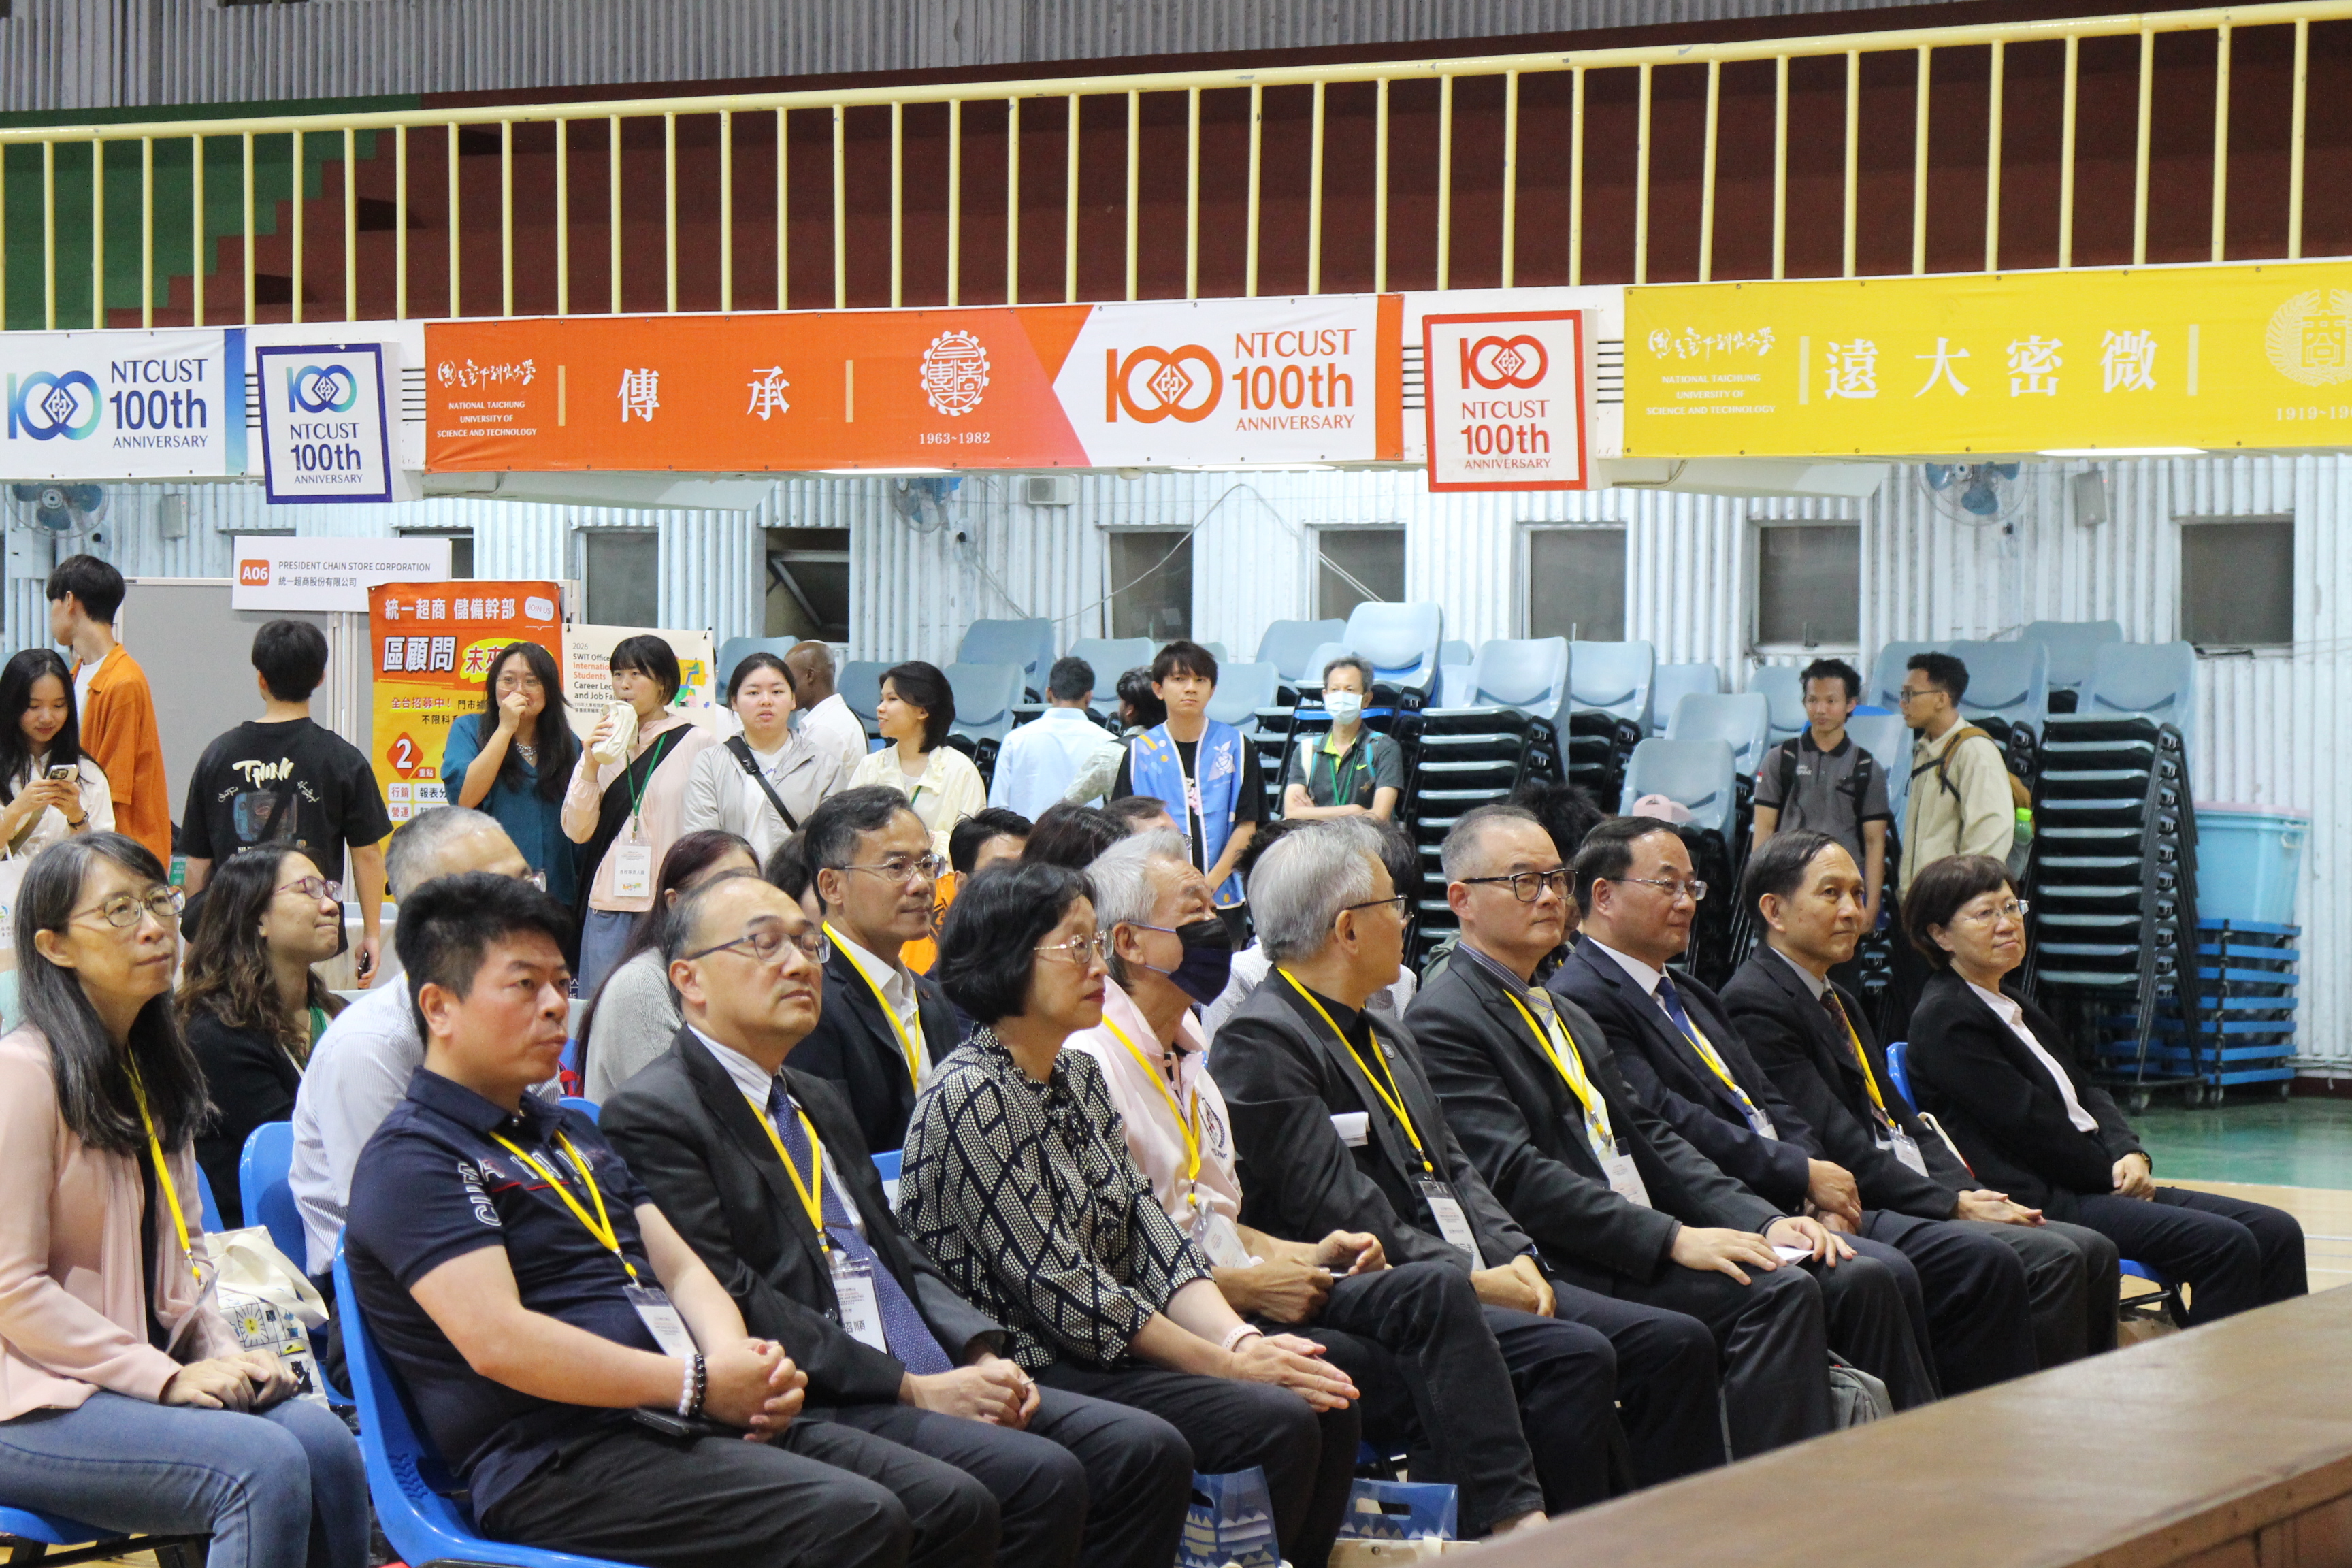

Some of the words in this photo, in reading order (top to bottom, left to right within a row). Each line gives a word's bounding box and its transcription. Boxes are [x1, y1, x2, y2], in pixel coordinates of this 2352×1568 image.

[1235, 329, 1357, 359] NTCUST
[112, 358, 208, 384] NTCUST
[1662, 375, 1709, 383] NATIONAL
[1711, 374, 1761, 382] TAICHUNG
[1232, 363, 1354, 410] 100th
[1676, 391, 1730, 399] UNIVERSITY
[1732, 390, 1745, 398] OF
[110, 390, 206, 430] 100th
[448, 402, 485, 410] NATIONAL
[1462, 399, 1550, 420] NTCUST
[1646, 407, 1686, 415] SCIENCE
[1688, 406, 1708, 414] AND
[1710, 405, 1776, 414] TECHNOLOGY
[459, 415, 502, 423] UNIVERSITY
[2276, 406, 2352, 421] 1919~19
[1236, 414, 1355, 431] ANNIVERSARY
[290, 422, 359, 440] NTCUST
[437, 429, 468, 438] SCIENCE
[487, 428, 537, 436] TECHNOLOGY
[112, 434, 208, 449] ANNIVERSARY
[1460, 423, 1550, 455] 100th
[290, 443, 361, 471] 100th
[1465, 458, 1551, 470] ANNIVERSARY
[294, 474, 363, 485] ANNIVERSARY
[242, 566, 268, 581] A06
[278, 561, 321, 570] PRESIDENT
[323, 562, 346, 570] CHAIN
[348, 562, 373, 571] STORE
[375, 563, 430, 572] CORPORATION
[278, 576, 357, 587] 統一超商股份有限公司
[385, 598, 446, 620] 統一超商
[453, 598, 516, 620] 儲備幹部
[527, 603, 542, 613] JOIN
[543, 606, 552, 615] US
[382, 636, 457, 672] 區顧問
[573, 653, 590, 662] SWIT
[591, 654, 610, 662] Office
[573, 662, 610, 671] Internatio
[574, 672, 606, 680] Students
[574, 682, 599, 690] Career
[600, 683, 612, 691] Lec
[396, 738, 413, 768] 2
[391, 787, 409, 798] 行銷
[419, 787, 446, 798] 報表分
[391, 806, 409, 818] 營運
